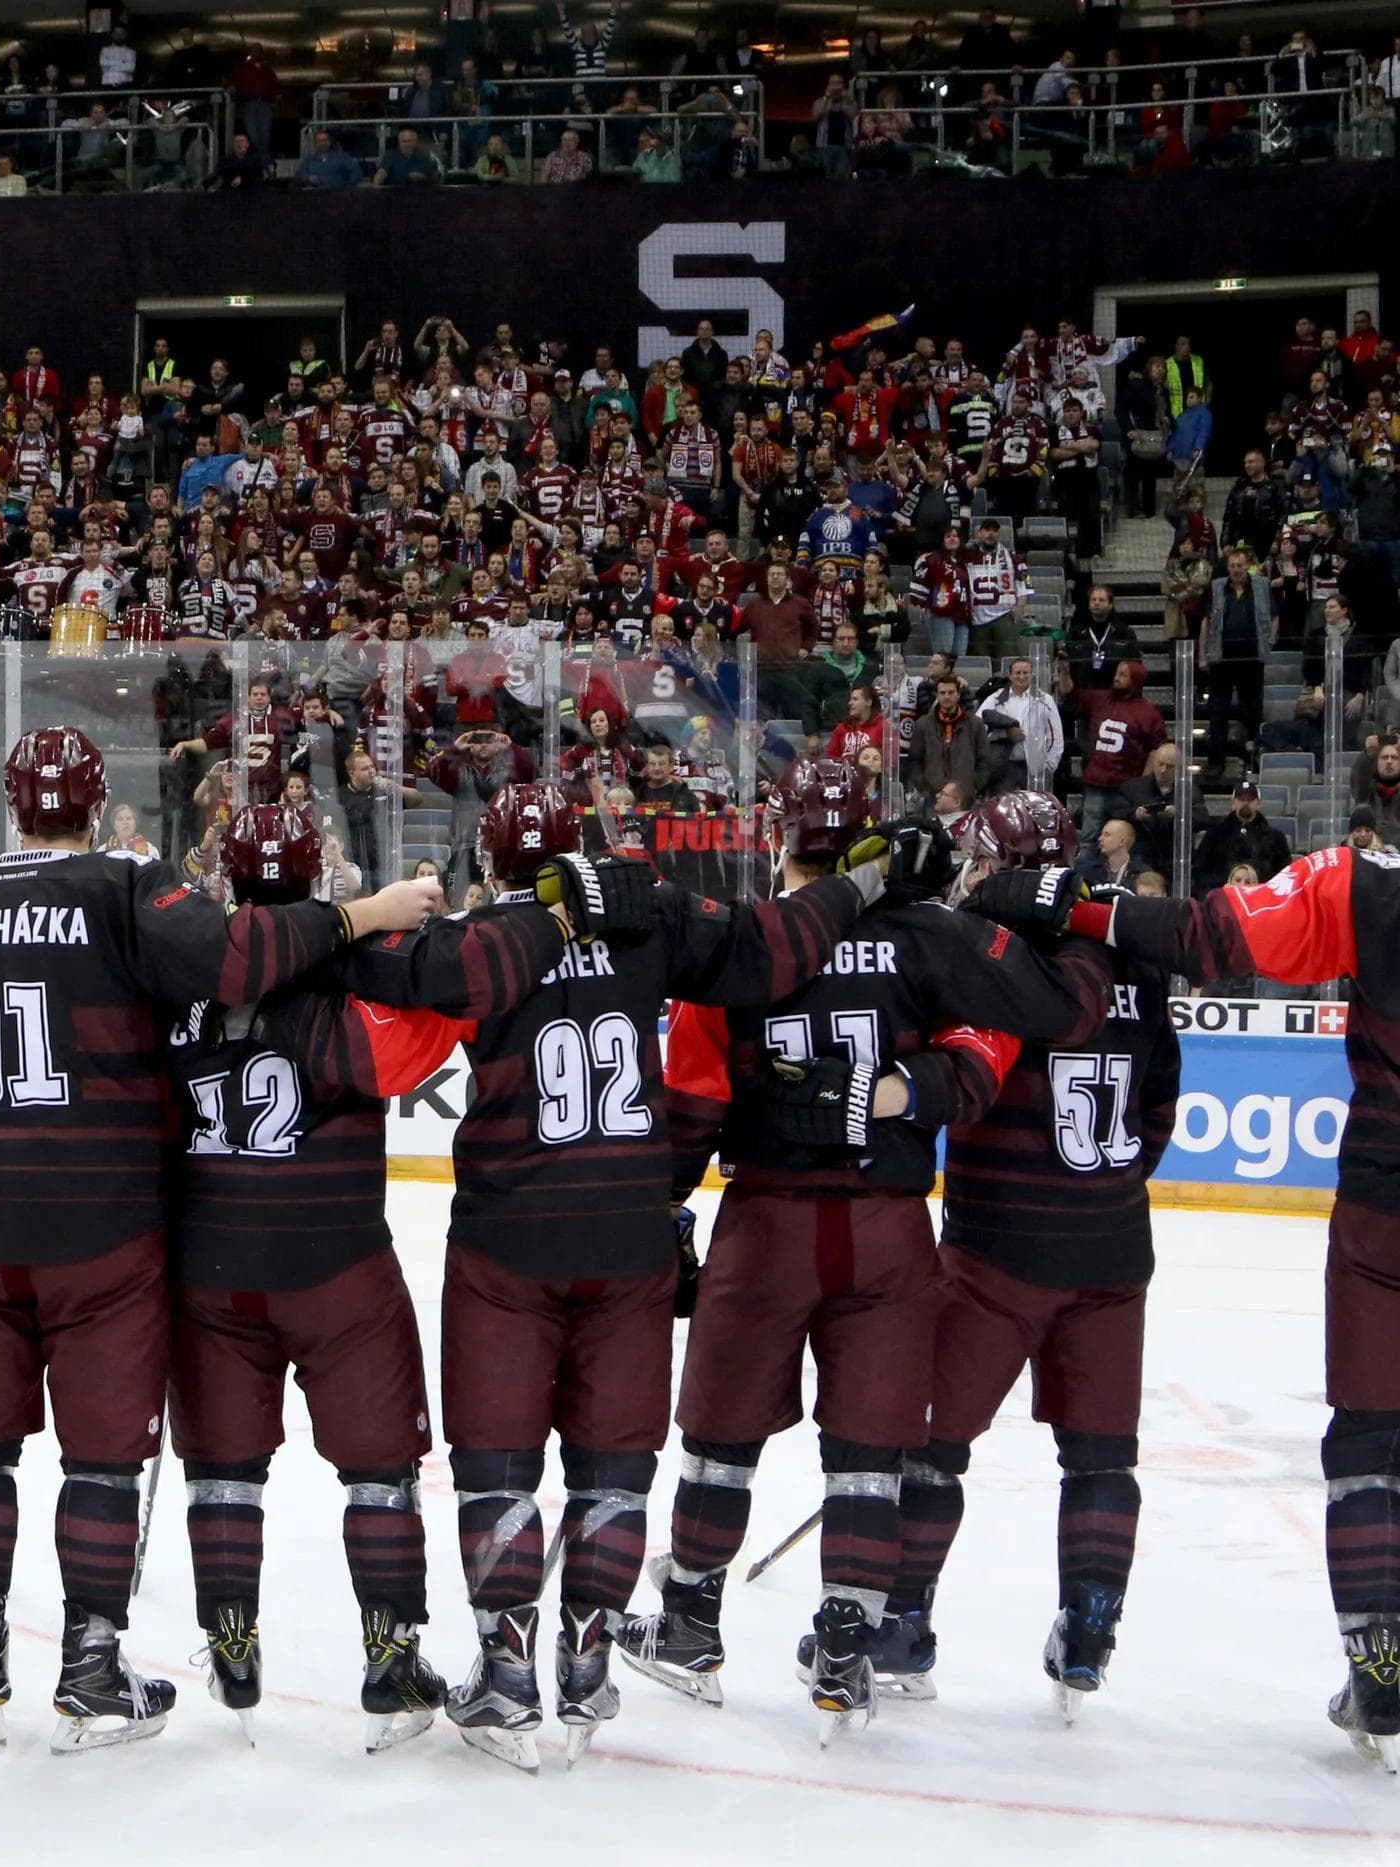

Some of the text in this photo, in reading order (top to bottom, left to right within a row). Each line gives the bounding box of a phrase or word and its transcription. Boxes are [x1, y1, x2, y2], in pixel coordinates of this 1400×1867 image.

[1095, 719, 1128, 753] S
[41, 791, 61, 810] 91
[826, 809, 841, 828] 11
[521, 831, 542, 849] 92
[262, 863, 281, 880] 12
[536, 1011, 654, 1145] 92
[186, 1050, 304, 1157] 12
[847, 1062, 876, 1147] WARRIOR
[1048, 1052, 1142, 1172] 51
